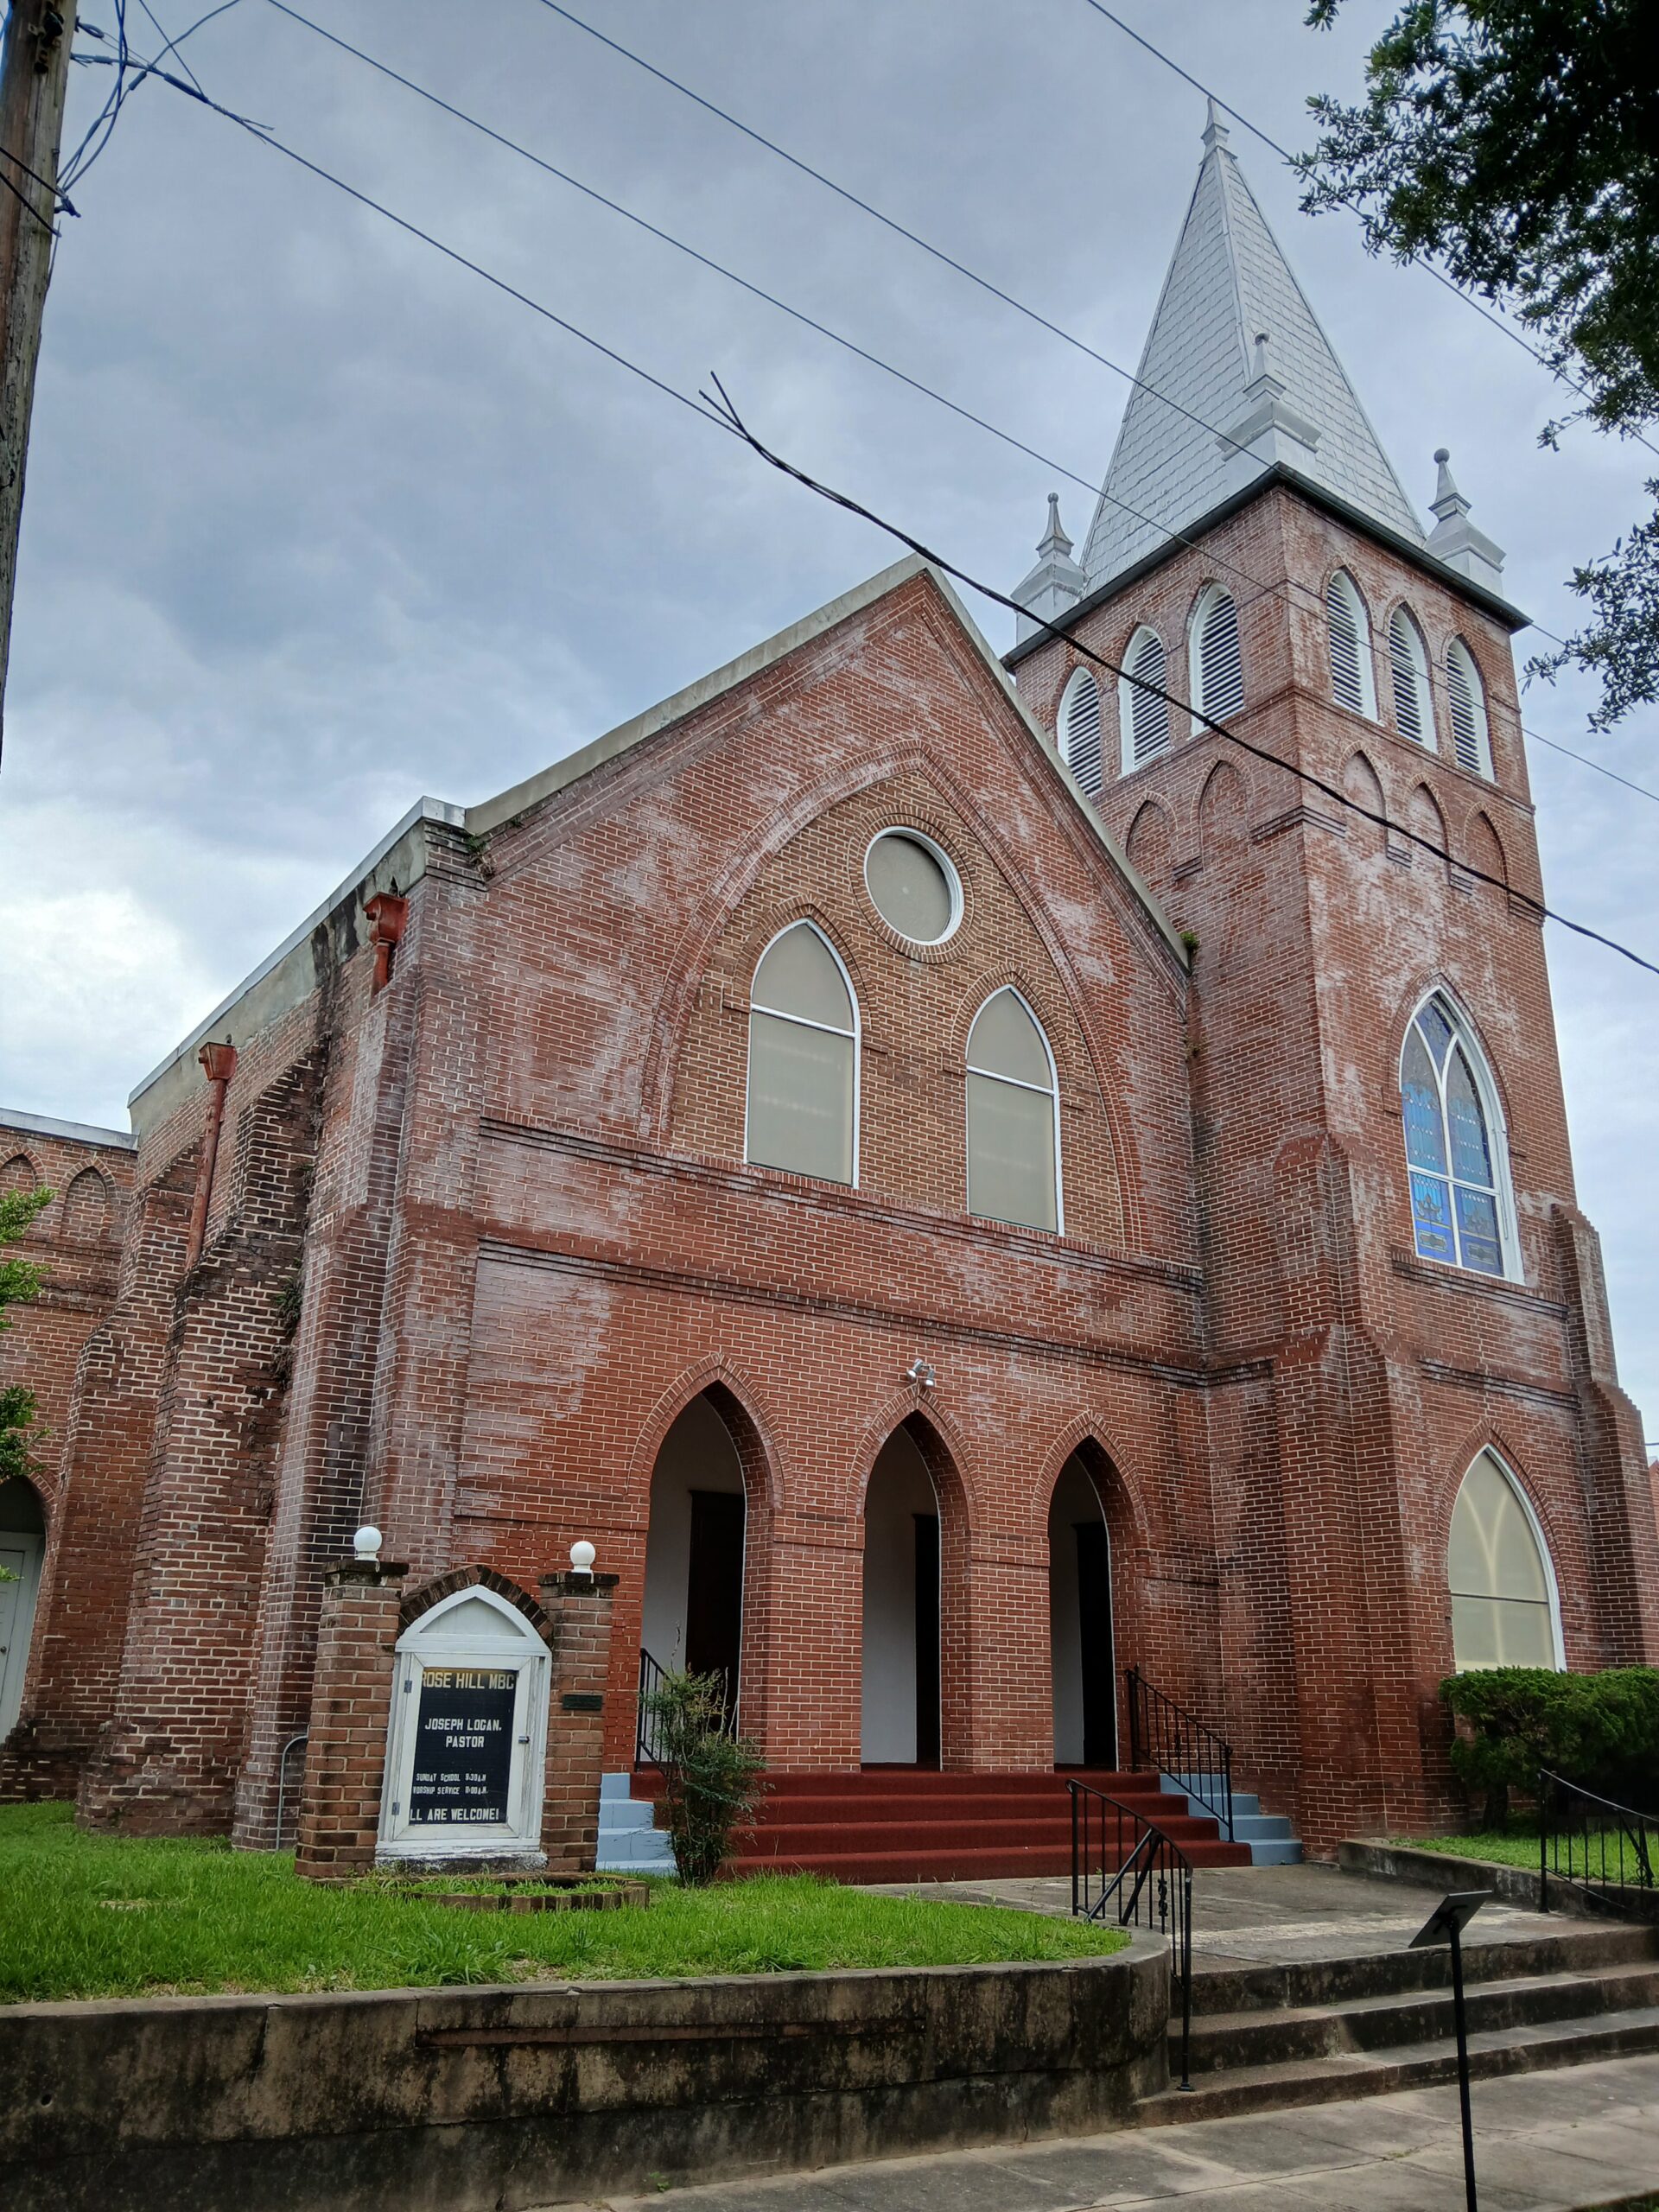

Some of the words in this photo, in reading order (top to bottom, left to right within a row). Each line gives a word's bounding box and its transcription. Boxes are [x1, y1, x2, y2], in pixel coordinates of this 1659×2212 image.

[455, 1672, 486, 1689] HILL
[488, 1673, 515, 1690] MBC
[424, 1718, 464, 1731] JOSEPH
[445, 1735, 485, 1748] PASTOR
[416, 1773, 437, 1783] SUNDAY
[440, 1773, 461, 1783] SCHOOL
[437, 1786, 460, 1795] SERVICE
[410, 1808, 423, 1821] LL
[427, 1808, 448, 1821] ARE
[451, 1808, 499, 1821] WELCOME!
